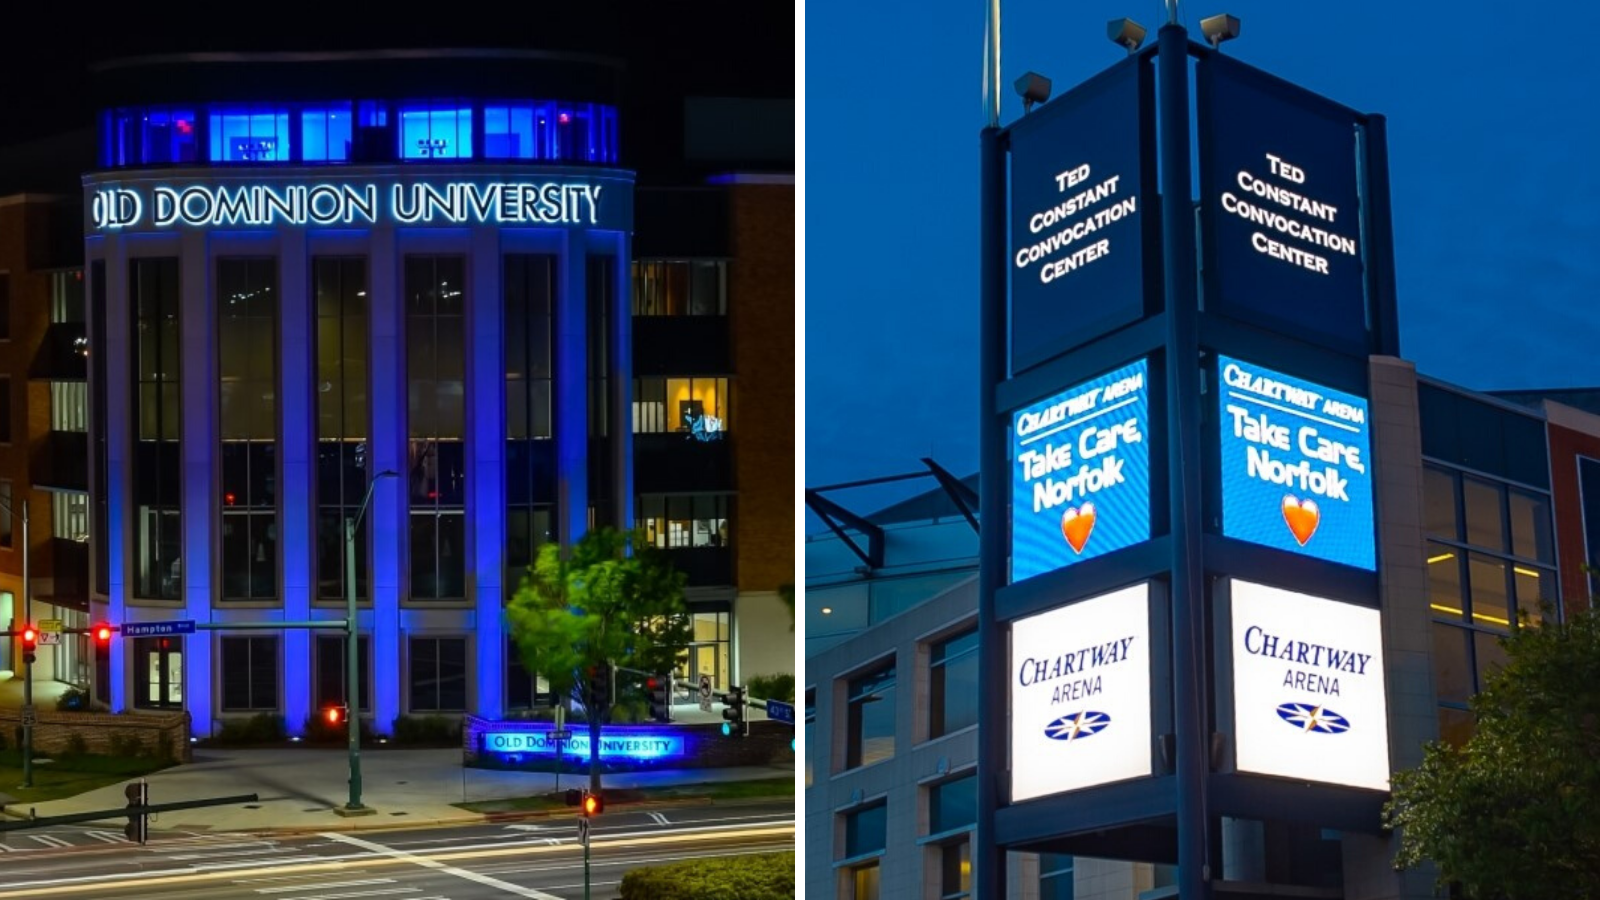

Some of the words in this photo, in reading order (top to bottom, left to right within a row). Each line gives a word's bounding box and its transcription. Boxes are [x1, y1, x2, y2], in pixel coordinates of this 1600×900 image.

[1055, 163, 1090, 192] TED
[1265, 153, 1305, 184] TED
[92, 188, 142, 229] OLD
[153, 185, 377, 227] DOMINION
[393, 182, 602, 224] UNIVERSITY
[1029, 175, 1119, 233] CONSTANT
[1237, 171, 1337, 222] CONSTANT
[1016, 196, 1136, 268] CONVOCATION
[1221, 192, 1355, 255] CONVOCATION
[1040, 239, 1110, 283] CENTER
[1252, 232, 1329, 274] CENTER
[1017, 388, 1099, 436] CHARTWAY
[1102, 372, 1143, 402] ARENA
[1224, 363, 1320, 409] CHARTWAY
[1322, 399, 1364, 424] ARENA
[1018, 443, 1072, 481] Take
[1078, 417, 1142, 459] Care,
[1226, 404, 1290, 451] Take
[1298, 426, 1365, 475] Care,
[1033, 455, 1125, 512] Norfolk
[1247, 445, 1349, 502] Norfolk
[127, 625, 172, 634] Hampton
[1244, 625, 1371, 675] CHARTWAY
[1019, 636, 1135, 687] CHARTWAY
[1282, 668, 1340, 697] ARENA
[1051, 674, 1103, 705] ARENA
[494, 736, 522, 748] OLD
[526, 736, 589, 750] DOMNION
